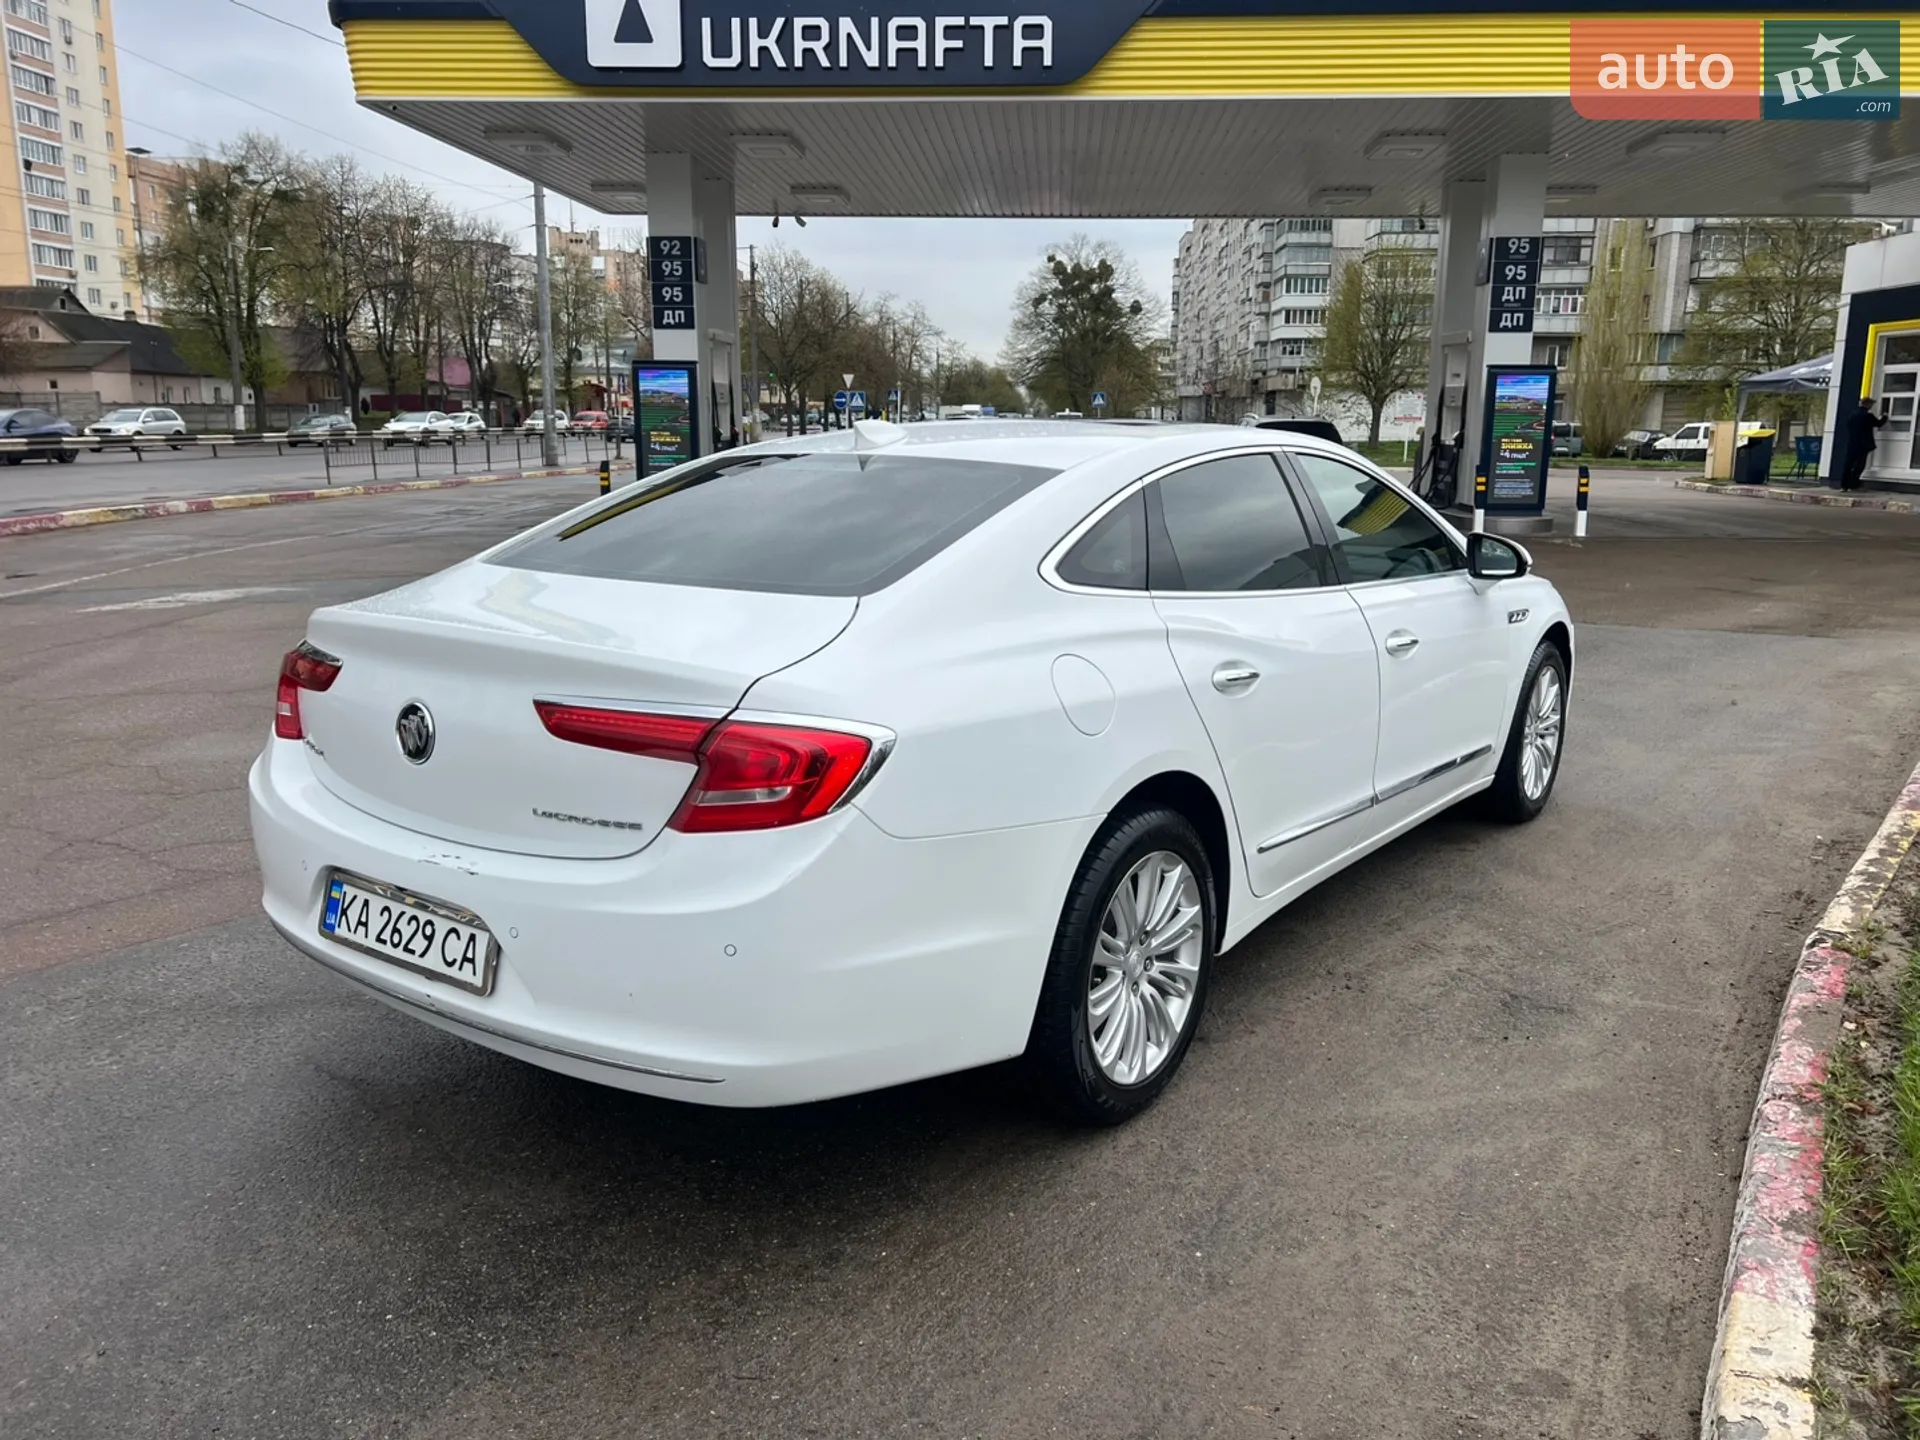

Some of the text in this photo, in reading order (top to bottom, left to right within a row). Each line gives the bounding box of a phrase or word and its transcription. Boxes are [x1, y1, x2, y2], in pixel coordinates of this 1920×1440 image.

[701, 15, 1053, 69] UKRNAFTA
[660, 240, 681, 255] 92
[1508, 238, 1530, 253] 95
[661, 261, 683, 276] 95
[1505, 265, 1527, 280] 95
[662, 287, 683, 302] 95
[1501, 286, 1526, 302] ДП
[662, 310, 685, 325] ДП
[1499, 313, 1524, 328] ДП
[325, 912, 336, 925] UA
[338, 891, 477, 977] KA 2629 CA
